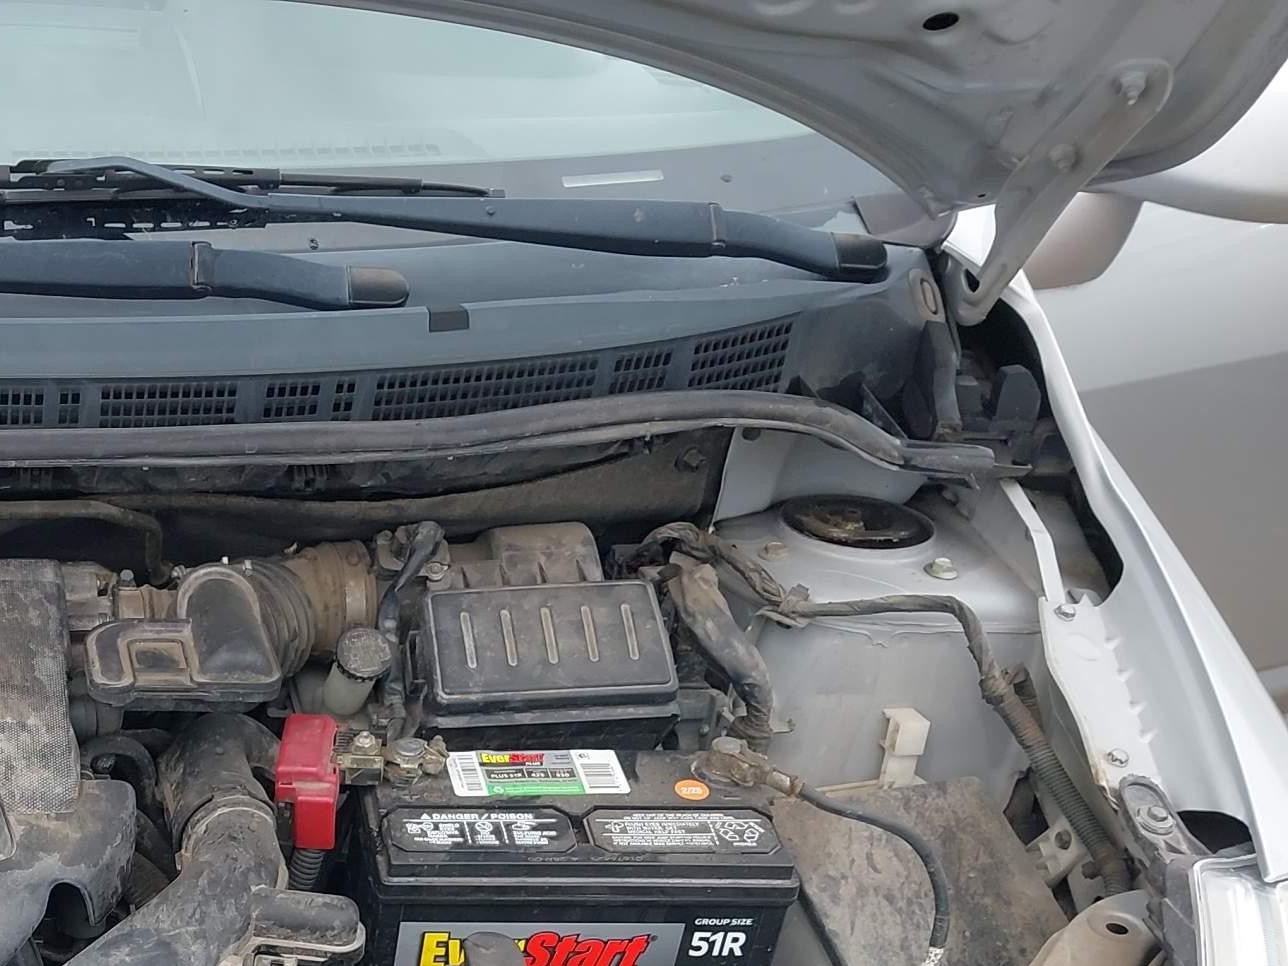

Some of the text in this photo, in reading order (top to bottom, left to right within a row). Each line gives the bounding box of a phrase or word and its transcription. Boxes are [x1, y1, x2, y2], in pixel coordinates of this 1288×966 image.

[481, 752, 544, 764] EverStart
[694, 918, 754, 926] GROUP SIZE
[688, 931, 747, 957] 51R
